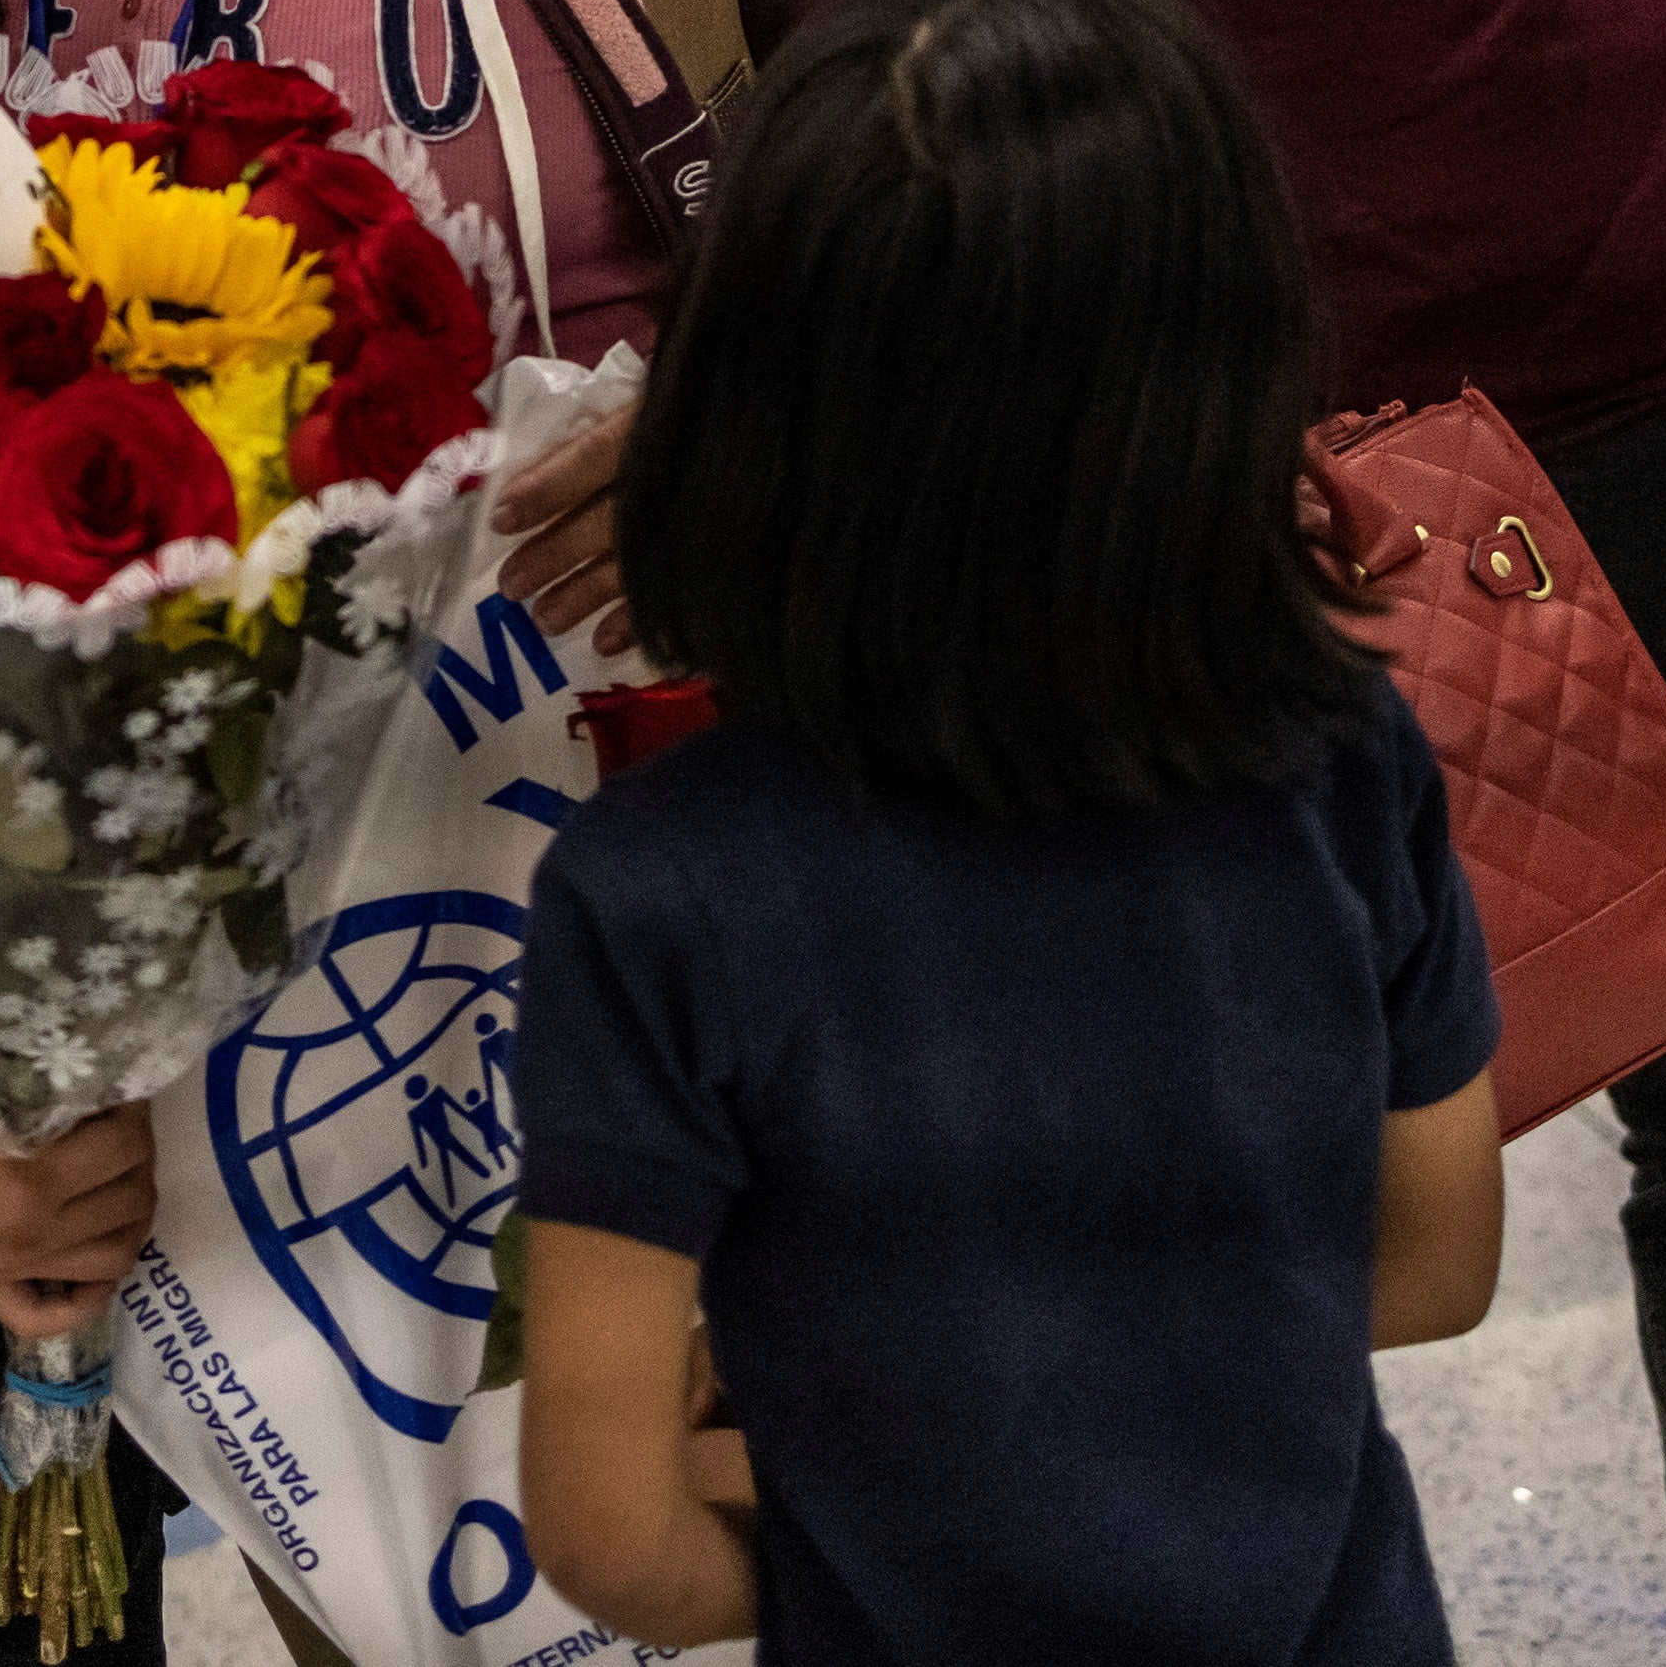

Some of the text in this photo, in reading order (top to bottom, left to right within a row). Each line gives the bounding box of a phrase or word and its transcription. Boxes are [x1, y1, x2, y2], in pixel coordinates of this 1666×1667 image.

[137, 1237, 320, 1508] PARA LAS MIGRA
[153, 1333, 320, 1573] ORGANIZACIÓN
[507, 1619, 619, 1667] TERN
